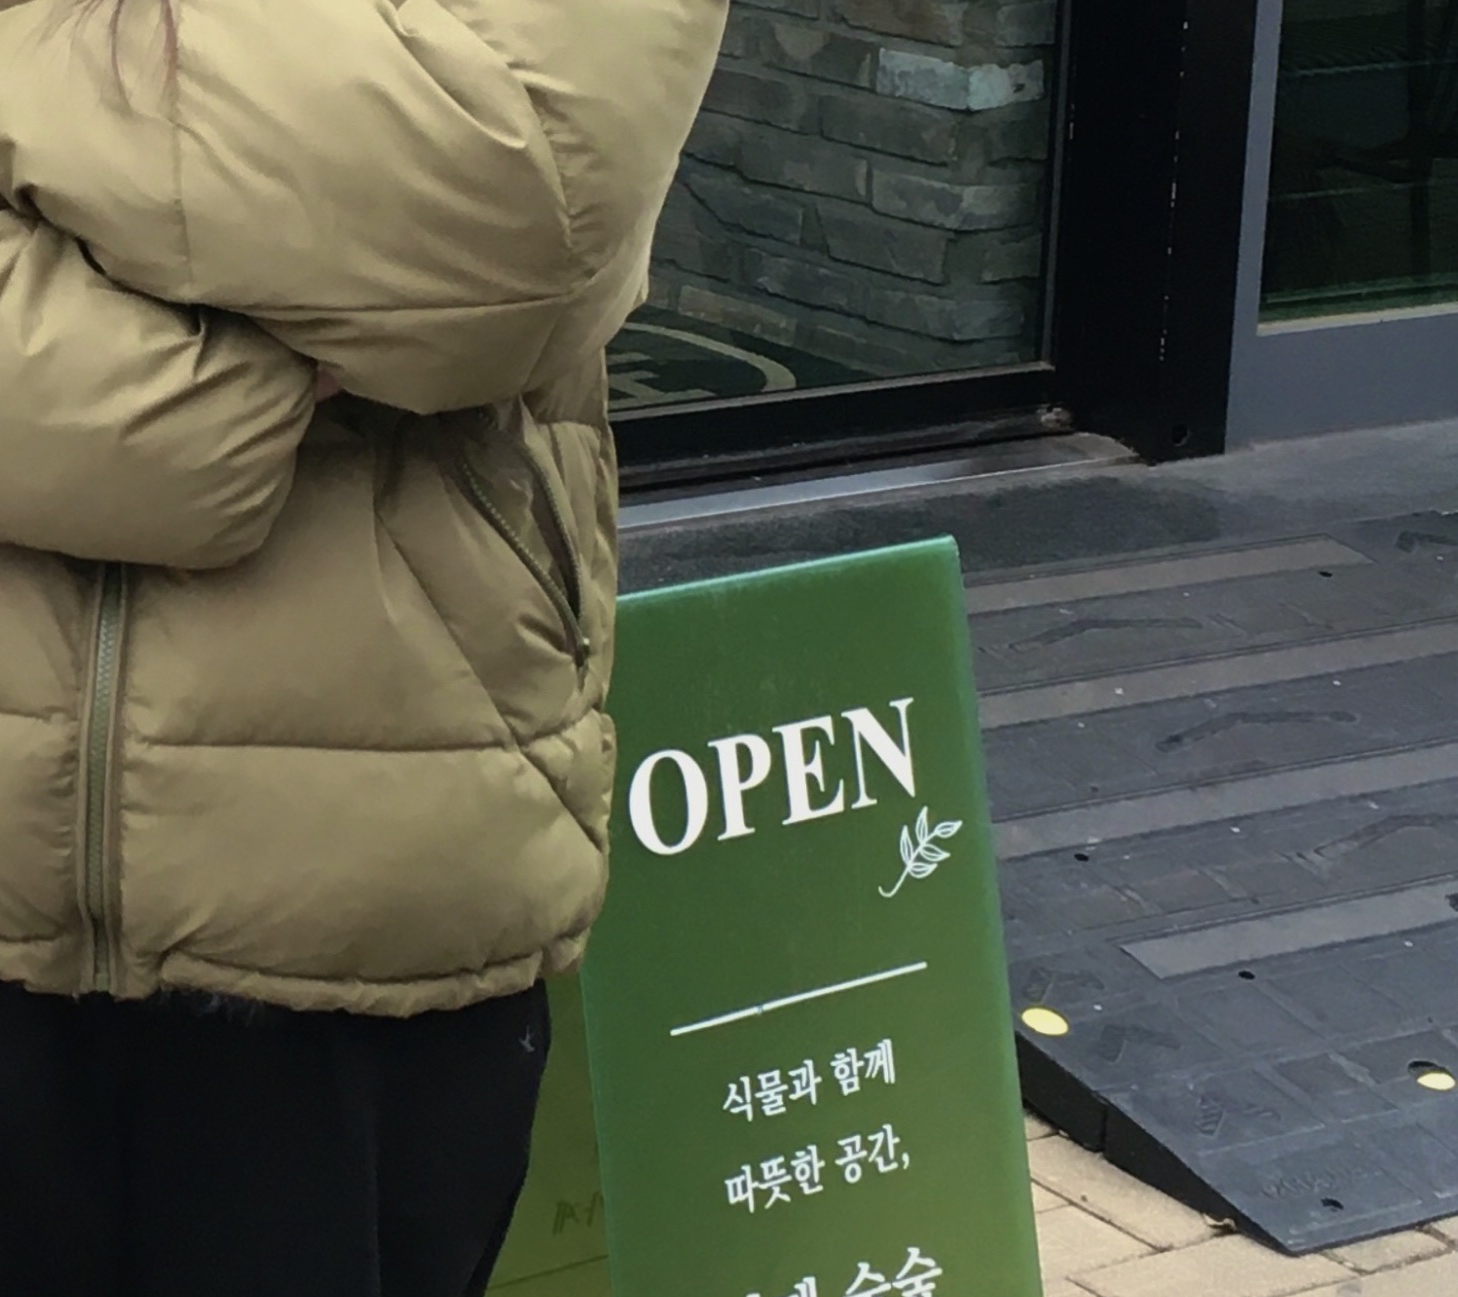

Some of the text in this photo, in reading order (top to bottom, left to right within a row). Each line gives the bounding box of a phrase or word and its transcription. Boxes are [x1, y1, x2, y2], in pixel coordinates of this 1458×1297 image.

[628, 697, 916, 856] OPEN
[722, 1038, 896, 1122] 식물과 함께
[724, 1123, 910, 1214] 따뜻한 공간,
